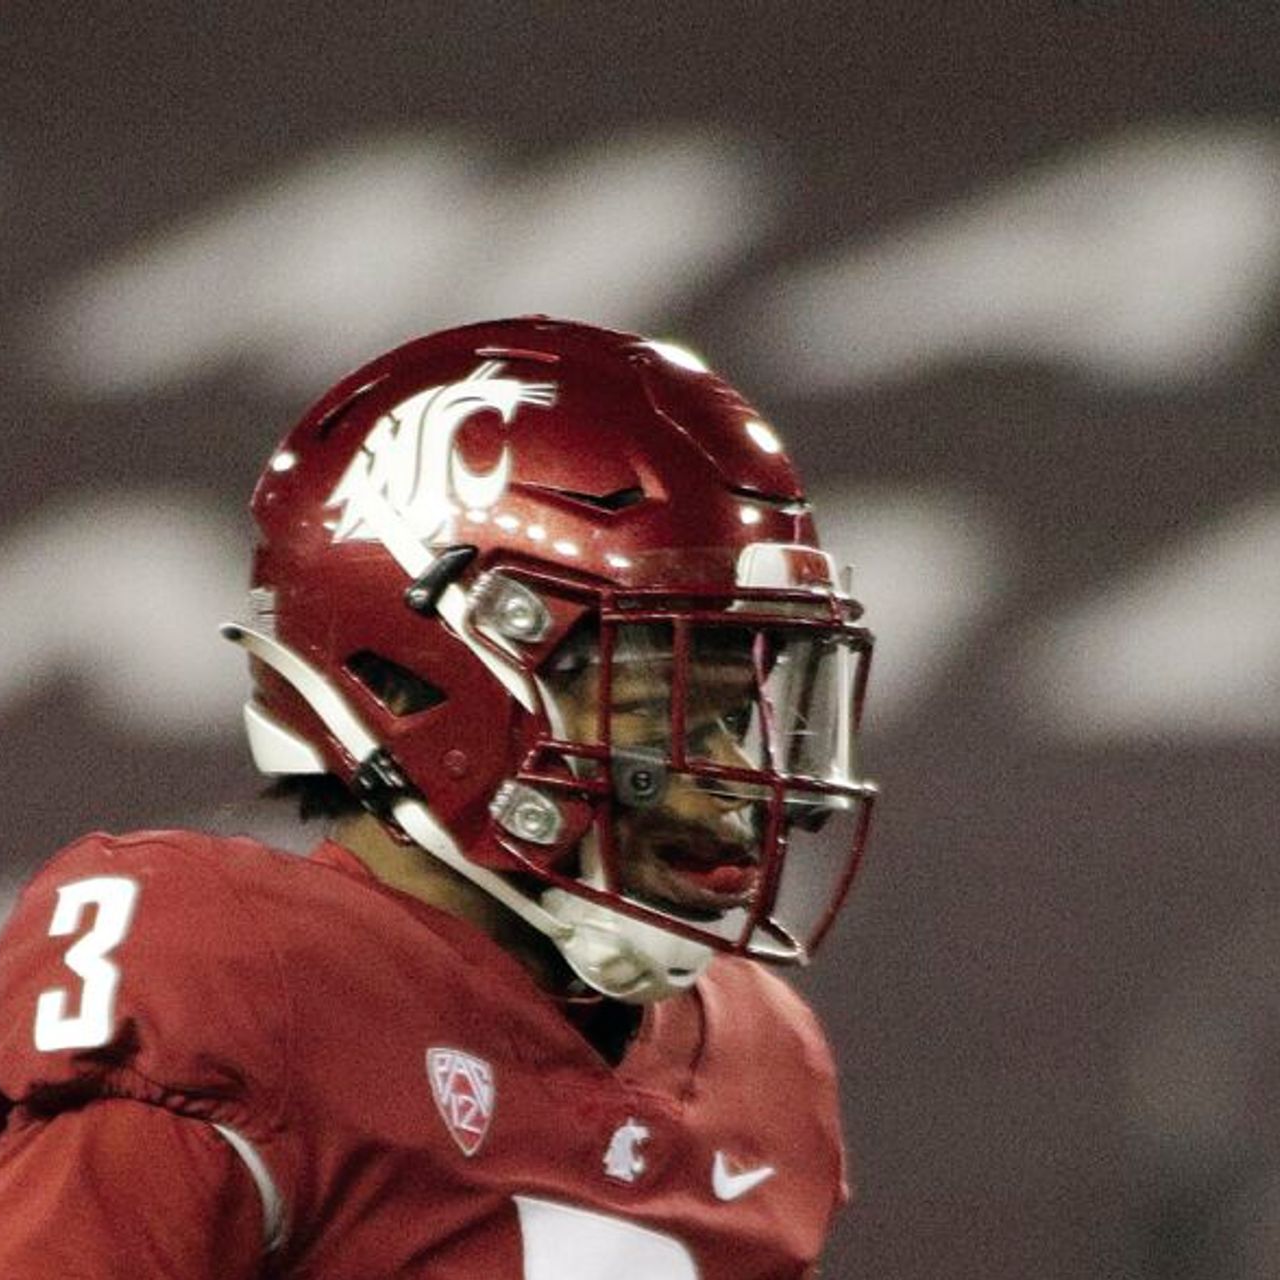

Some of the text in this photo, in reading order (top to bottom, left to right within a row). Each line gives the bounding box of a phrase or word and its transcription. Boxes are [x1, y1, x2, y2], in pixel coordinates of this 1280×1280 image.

[33, 876, 139, 1053] 3
[429, 1052, 493, 1116] PAC
[451, 1094, 483, 1134] 12
